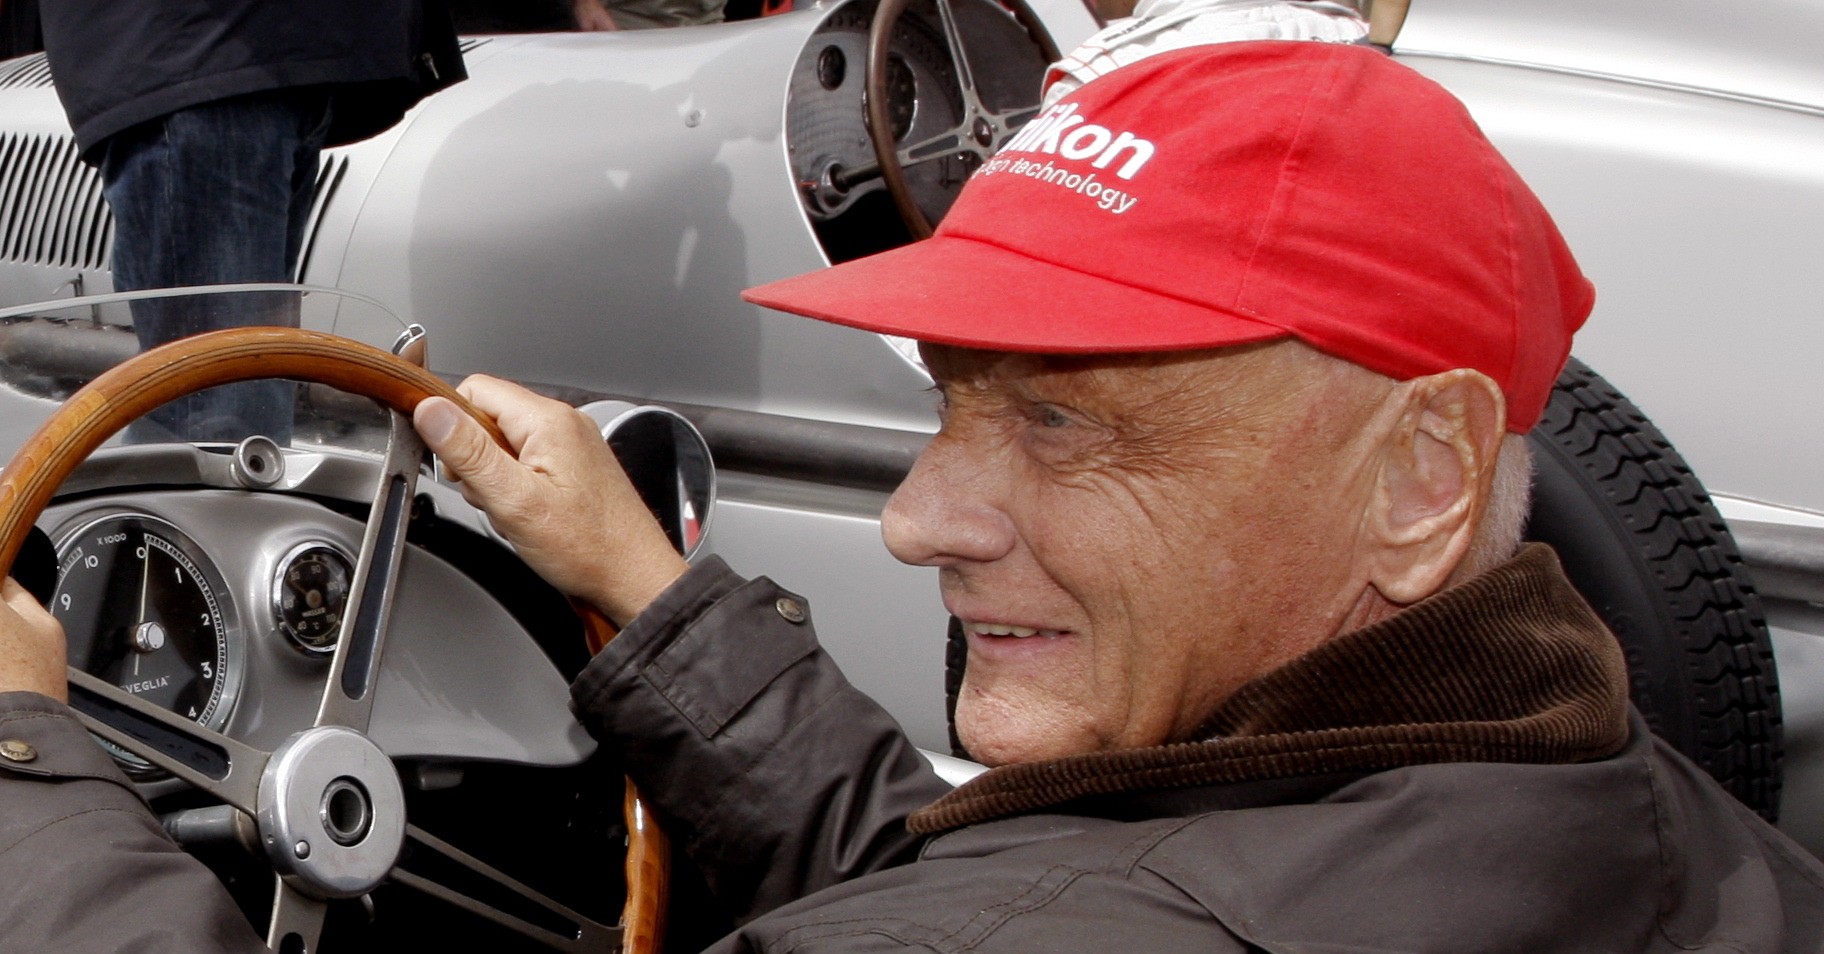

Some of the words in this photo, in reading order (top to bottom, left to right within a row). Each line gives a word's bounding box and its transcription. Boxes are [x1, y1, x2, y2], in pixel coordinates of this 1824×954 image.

[1010, 158, 1138, 214] technology
[136, 547, 146, 559] 0
[85, 555, 99, 569] 10
[174, 567, 182, 584] 1
[61, 593, 72, 611] 9
[200, 613, 211, 626] 2
[200, 661, 213, 679] 3
[188, 706, 197, 719] 4
